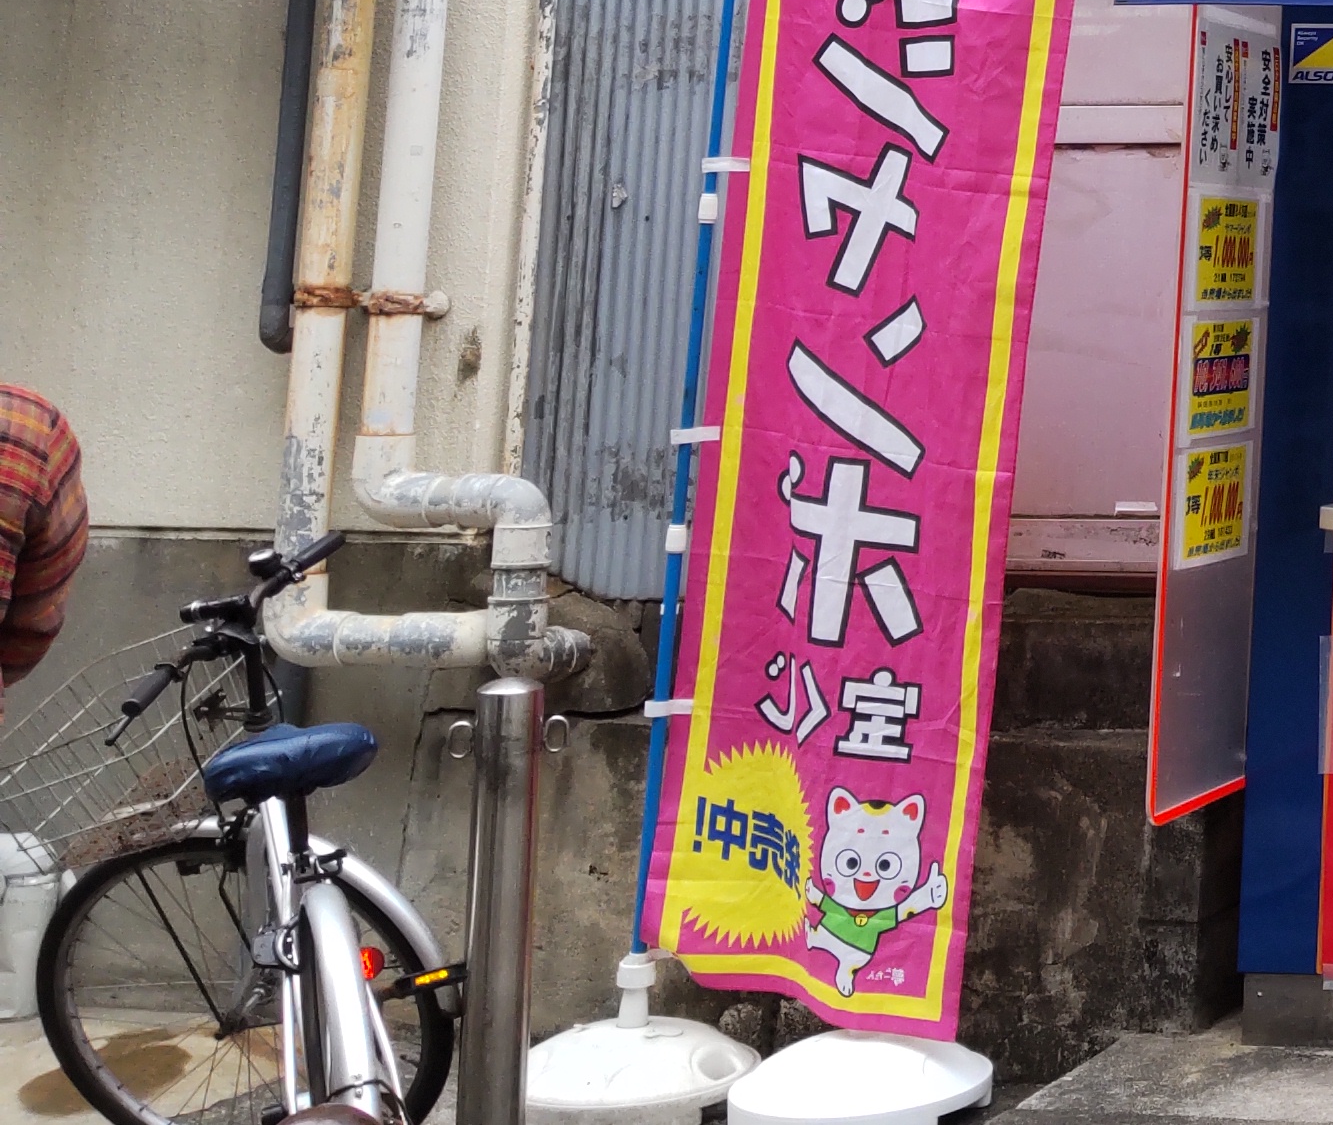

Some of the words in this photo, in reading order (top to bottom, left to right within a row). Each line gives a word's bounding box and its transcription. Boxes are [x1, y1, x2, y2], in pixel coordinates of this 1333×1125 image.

[1210, 55, 1225, 153] お買い求め
[1223, 43, 1234, 123] 安心して
[1257, 49, 1272, 146] 安全対策
[1198, 88, 1212, 166] ください
[1245, 95, 1258, 170] 実施中
